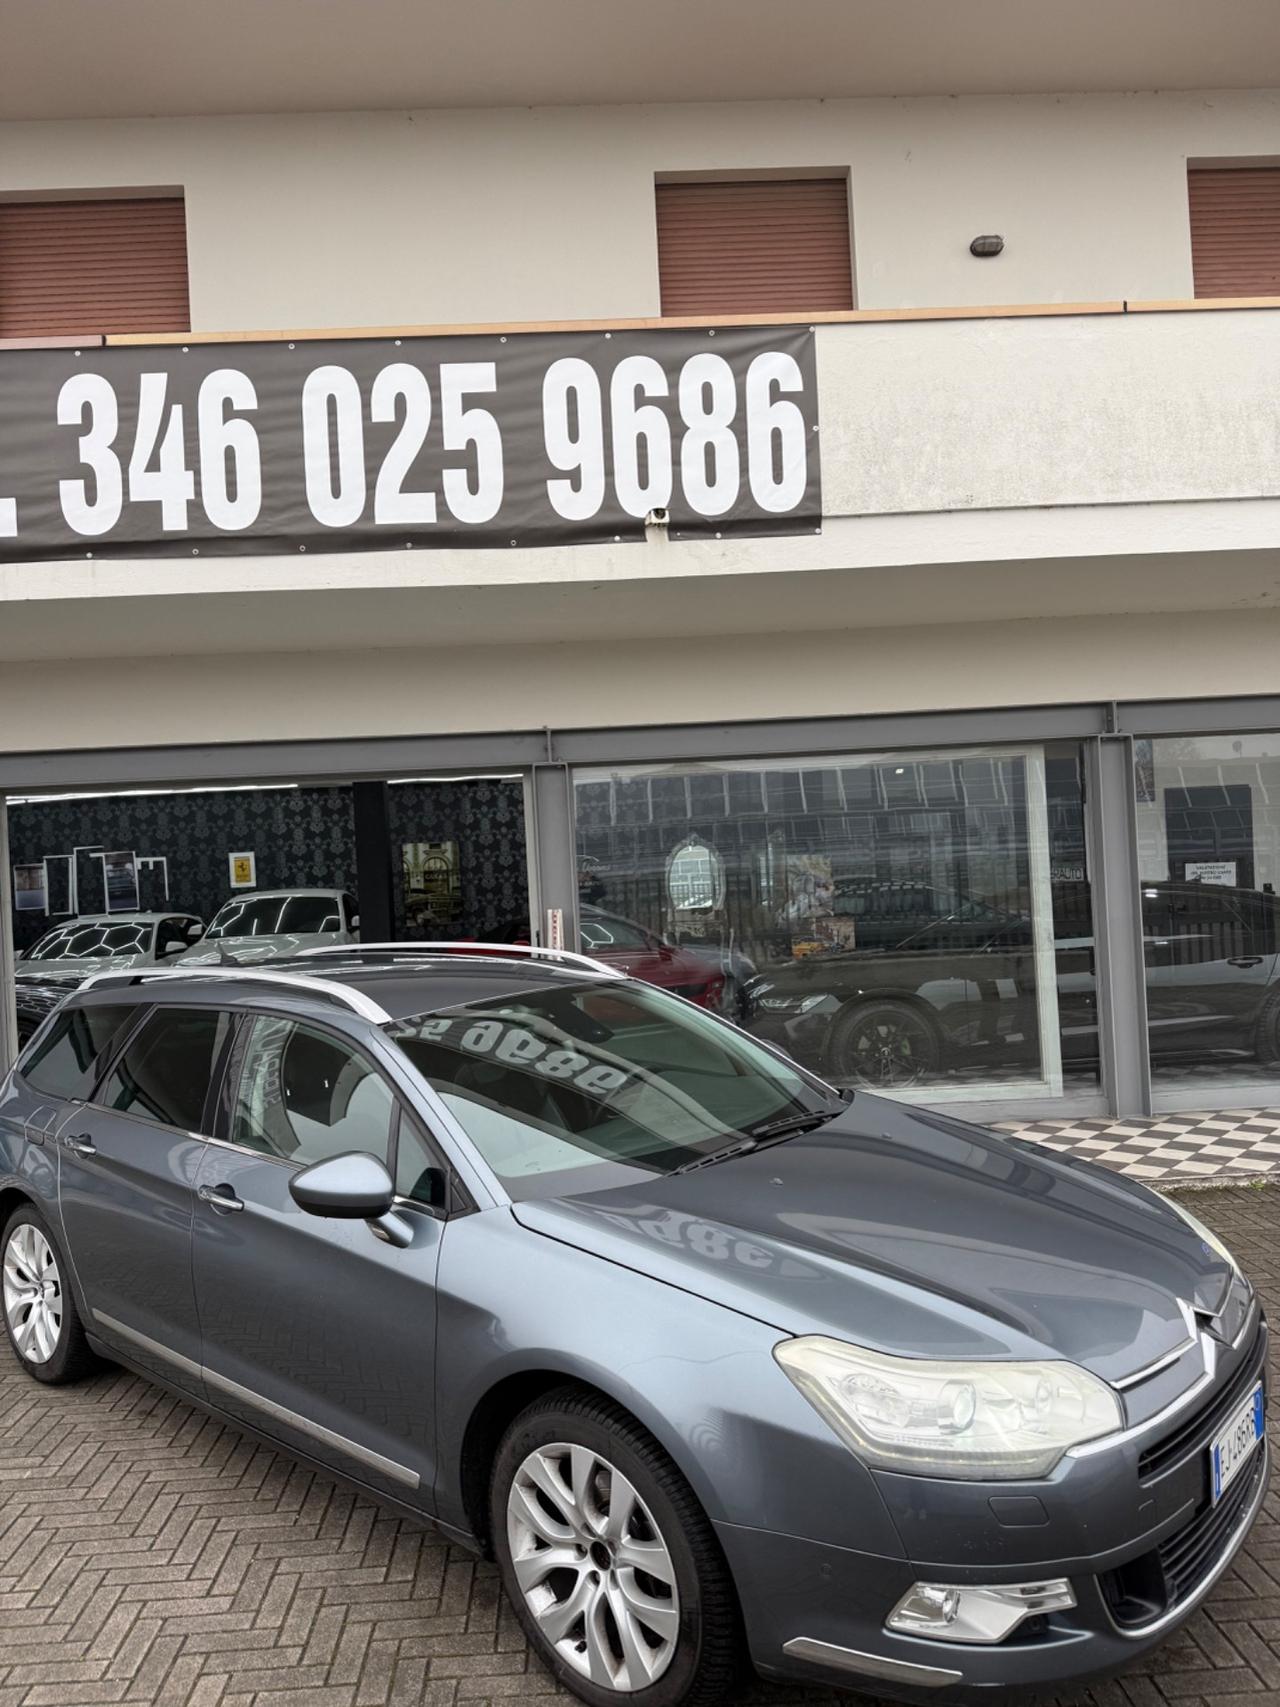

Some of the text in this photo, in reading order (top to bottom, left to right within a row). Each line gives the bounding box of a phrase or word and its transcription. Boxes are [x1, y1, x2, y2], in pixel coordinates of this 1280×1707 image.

[57, 352, 807, 536] 346 025 9686
